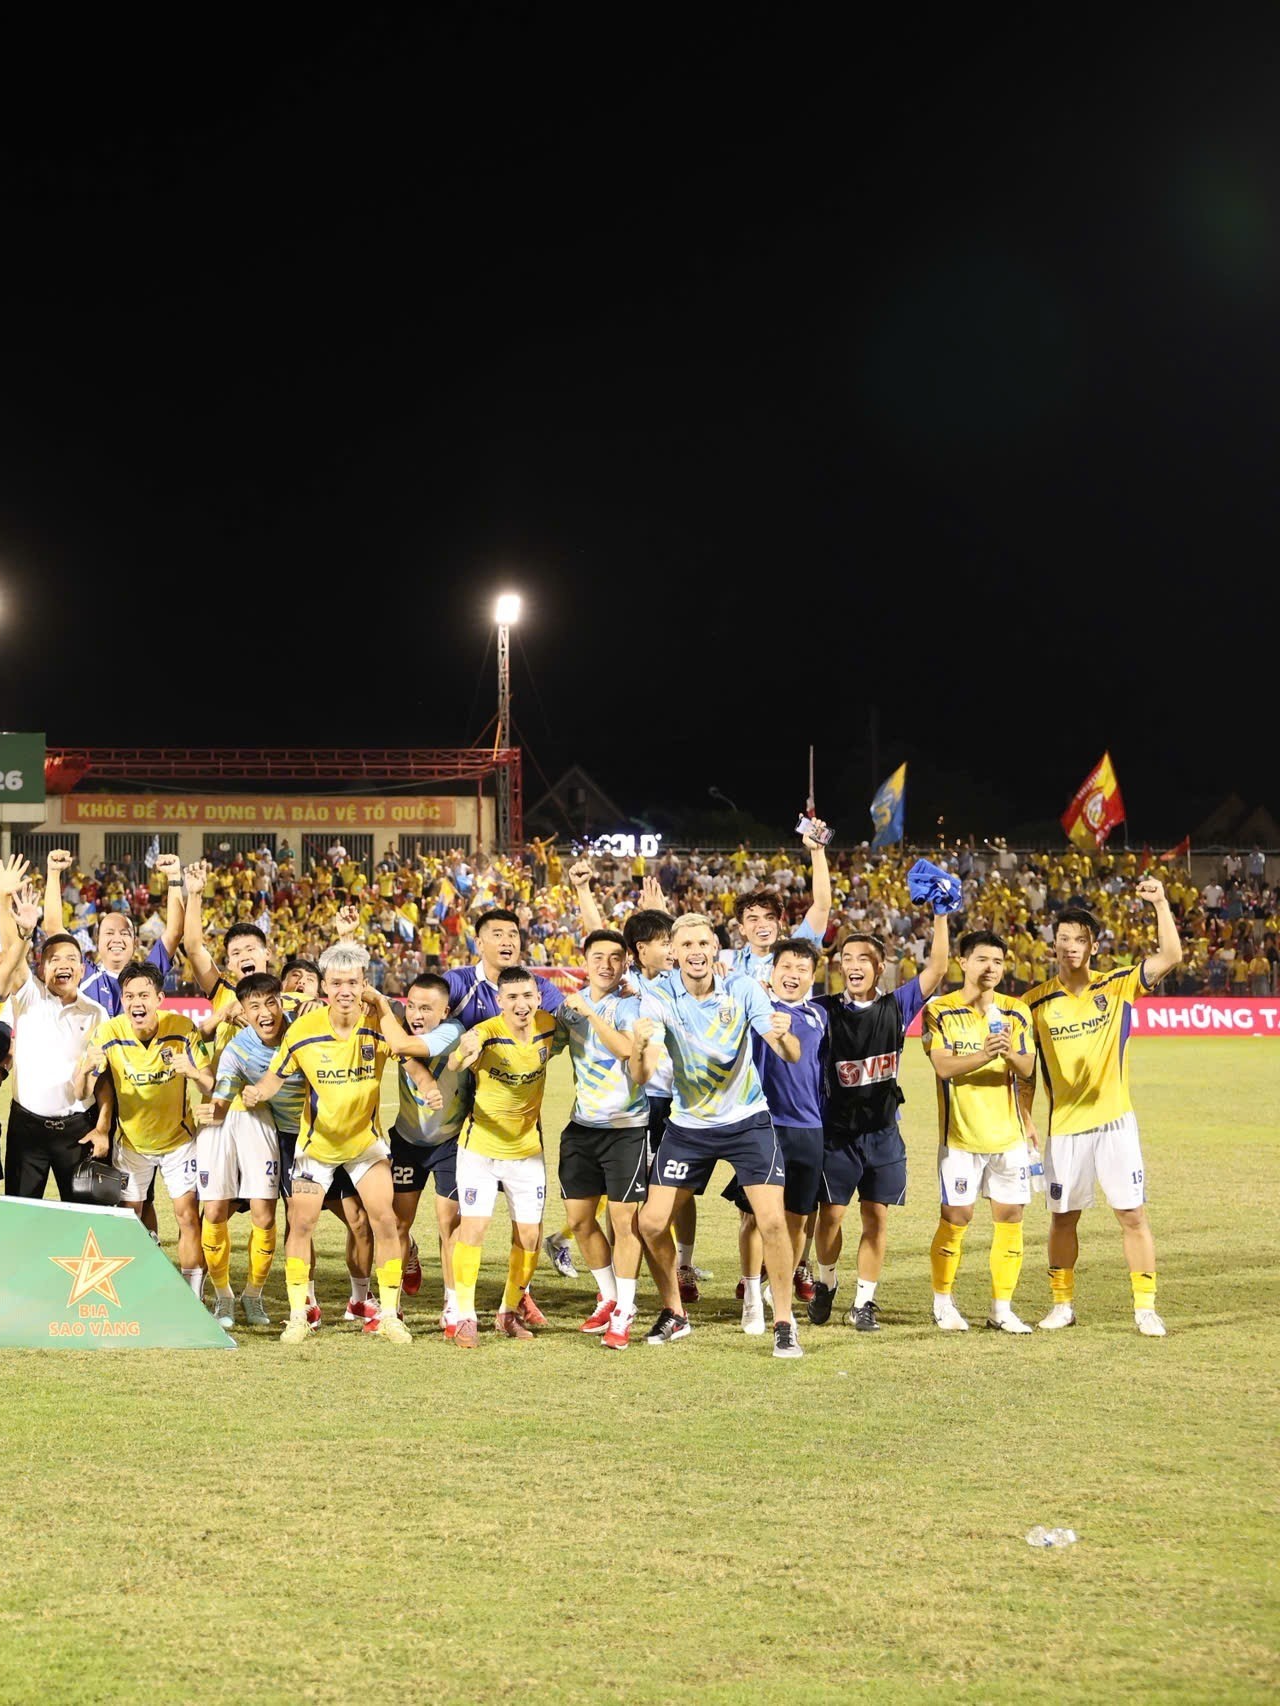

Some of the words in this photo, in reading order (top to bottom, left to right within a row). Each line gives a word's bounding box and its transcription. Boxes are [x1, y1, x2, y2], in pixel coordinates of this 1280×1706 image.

[162, 801, 199, 818] XÂY
[261, 802, 287, 820] VÀ
[391, 799, 441, 820] QUỐC
[1147, 1003, 1254, 1029] NHỮNG
[1259, 1008, 1280, 1029] T
[1050, 1023, 1081, 1036] BAC
[954, 1041, 982, 1051] BAC
[316, 1069, 346, 1079] BAC
[265, 1160, 278, 1176] 28
[392, 1166, 415, 1184] 22
[663, 1158, 689, 1180] 20
[78, 1304, 109, 1319] BIA
[48, 1321, 85, 1337] SAO
[89, 1319, 141, 1337] VÀNG
